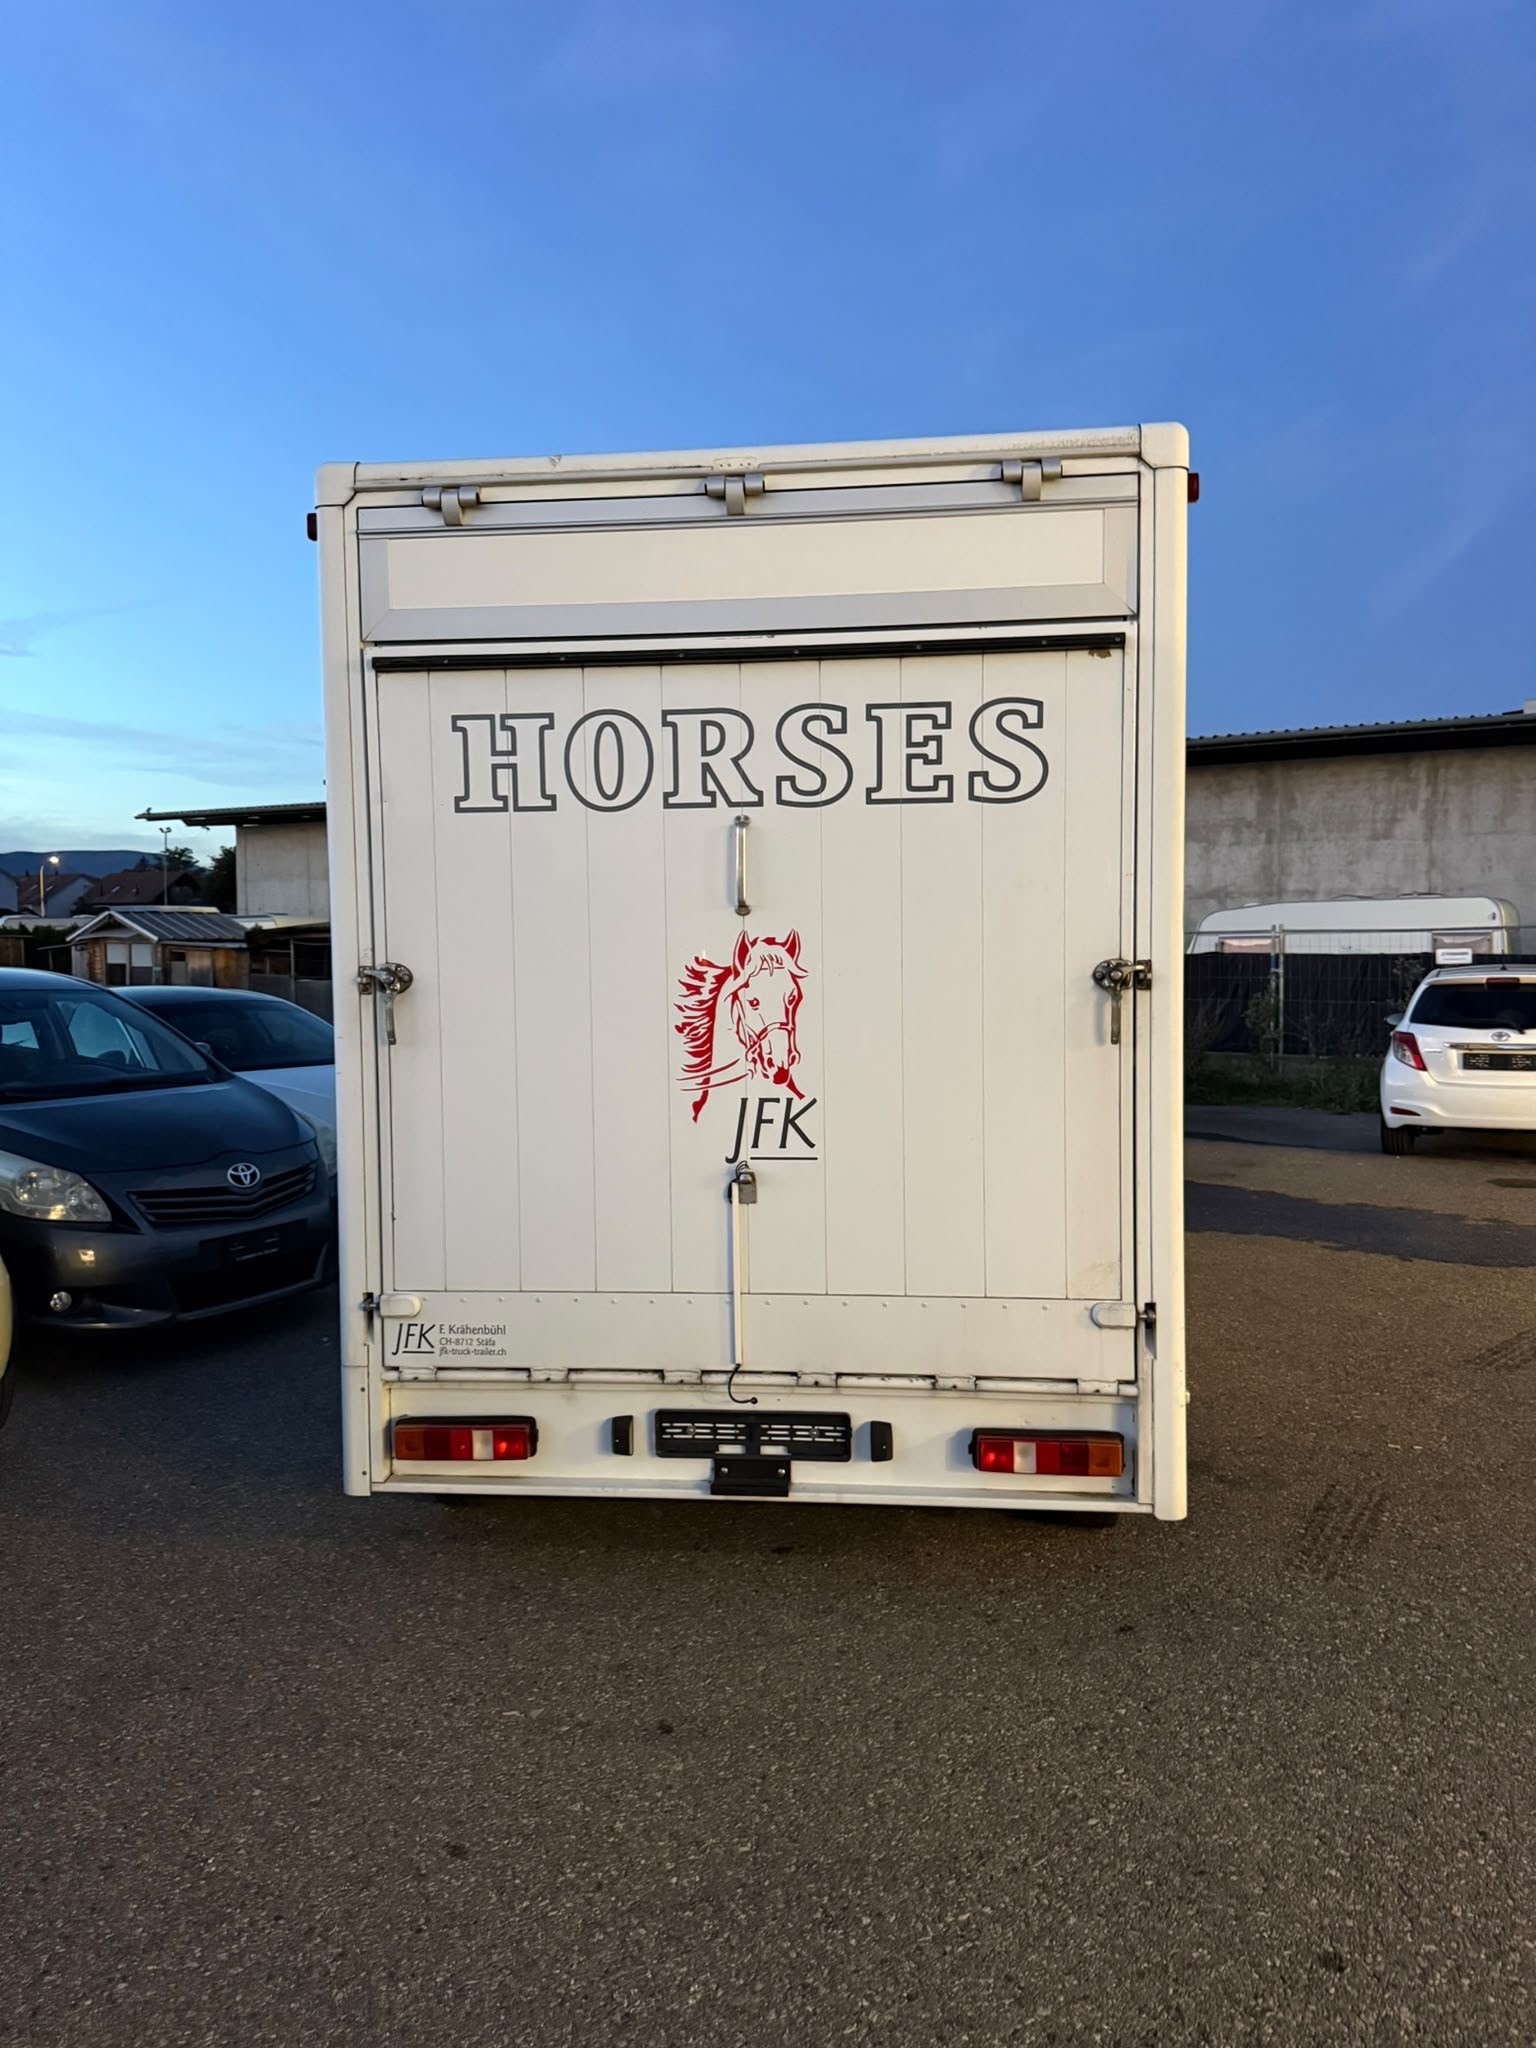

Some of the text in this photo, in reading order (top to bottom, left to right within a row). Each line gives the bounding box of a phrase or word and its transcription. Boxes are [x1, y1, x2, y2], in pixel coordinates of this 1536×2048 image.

[451, 697, 1049, 813] HORSES
[725, 1097, 818, 1163] JFK
[391, 1323, 436, 1356] JFK
[439, 1324, 507, 1336] F. Krähenbühl
[438, 1346, 507, 1357] jfk-truck-trailer.ch
[439, 1337, 496, 1346] CH-8712 Stäfa
